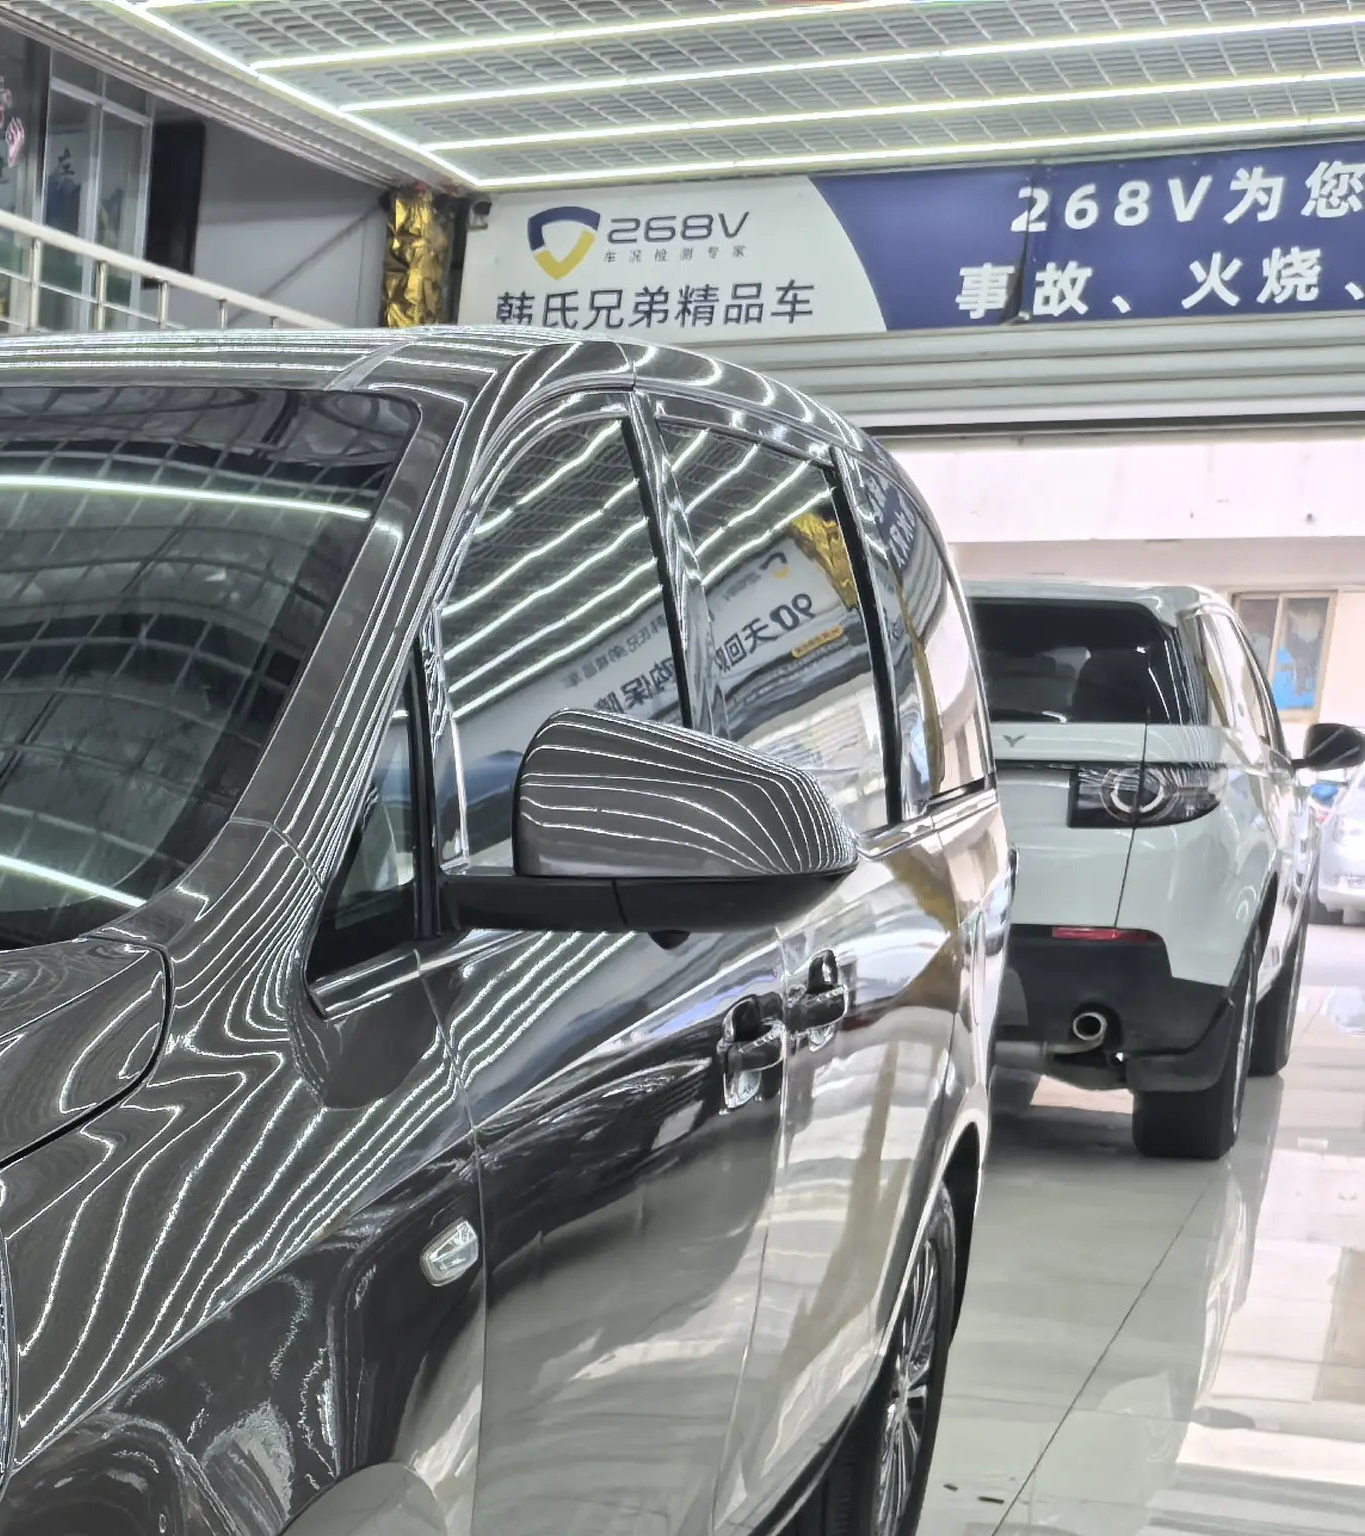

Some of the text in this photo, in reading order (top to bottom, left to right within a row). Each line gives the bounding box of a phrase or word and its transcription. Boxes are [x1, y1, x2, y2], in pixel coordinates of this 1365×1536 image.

[607, 211, 750, 244] 268V
[604, 244, 747, 264] 车况检测专家
[496, 279, 815, 331] 韩氏兄弟精品车
